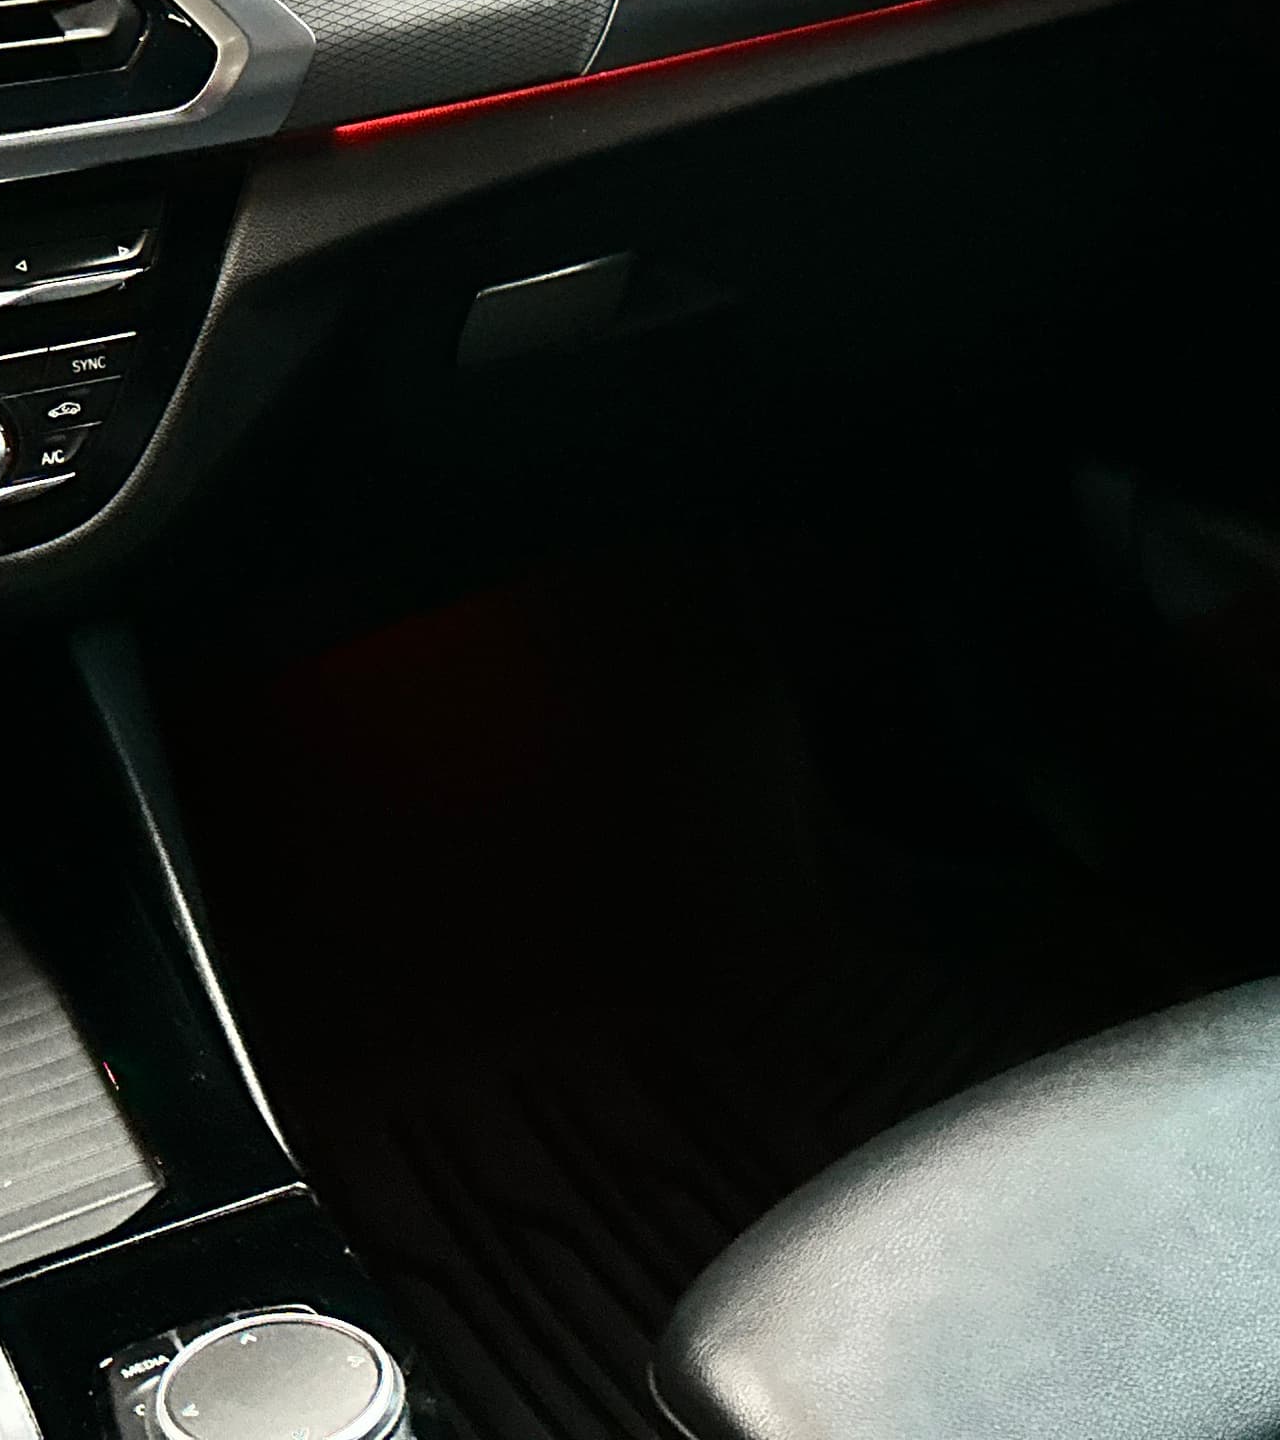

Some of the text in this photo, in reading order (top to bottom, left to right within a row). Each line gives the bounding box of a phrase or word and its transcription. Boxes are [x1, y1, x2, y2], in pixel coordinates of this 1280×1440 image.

[72, 356, 106, 373] SYNC
[41, 448, 65, 466] A/C
[120, 1354, 170, 1379] MEDIA
